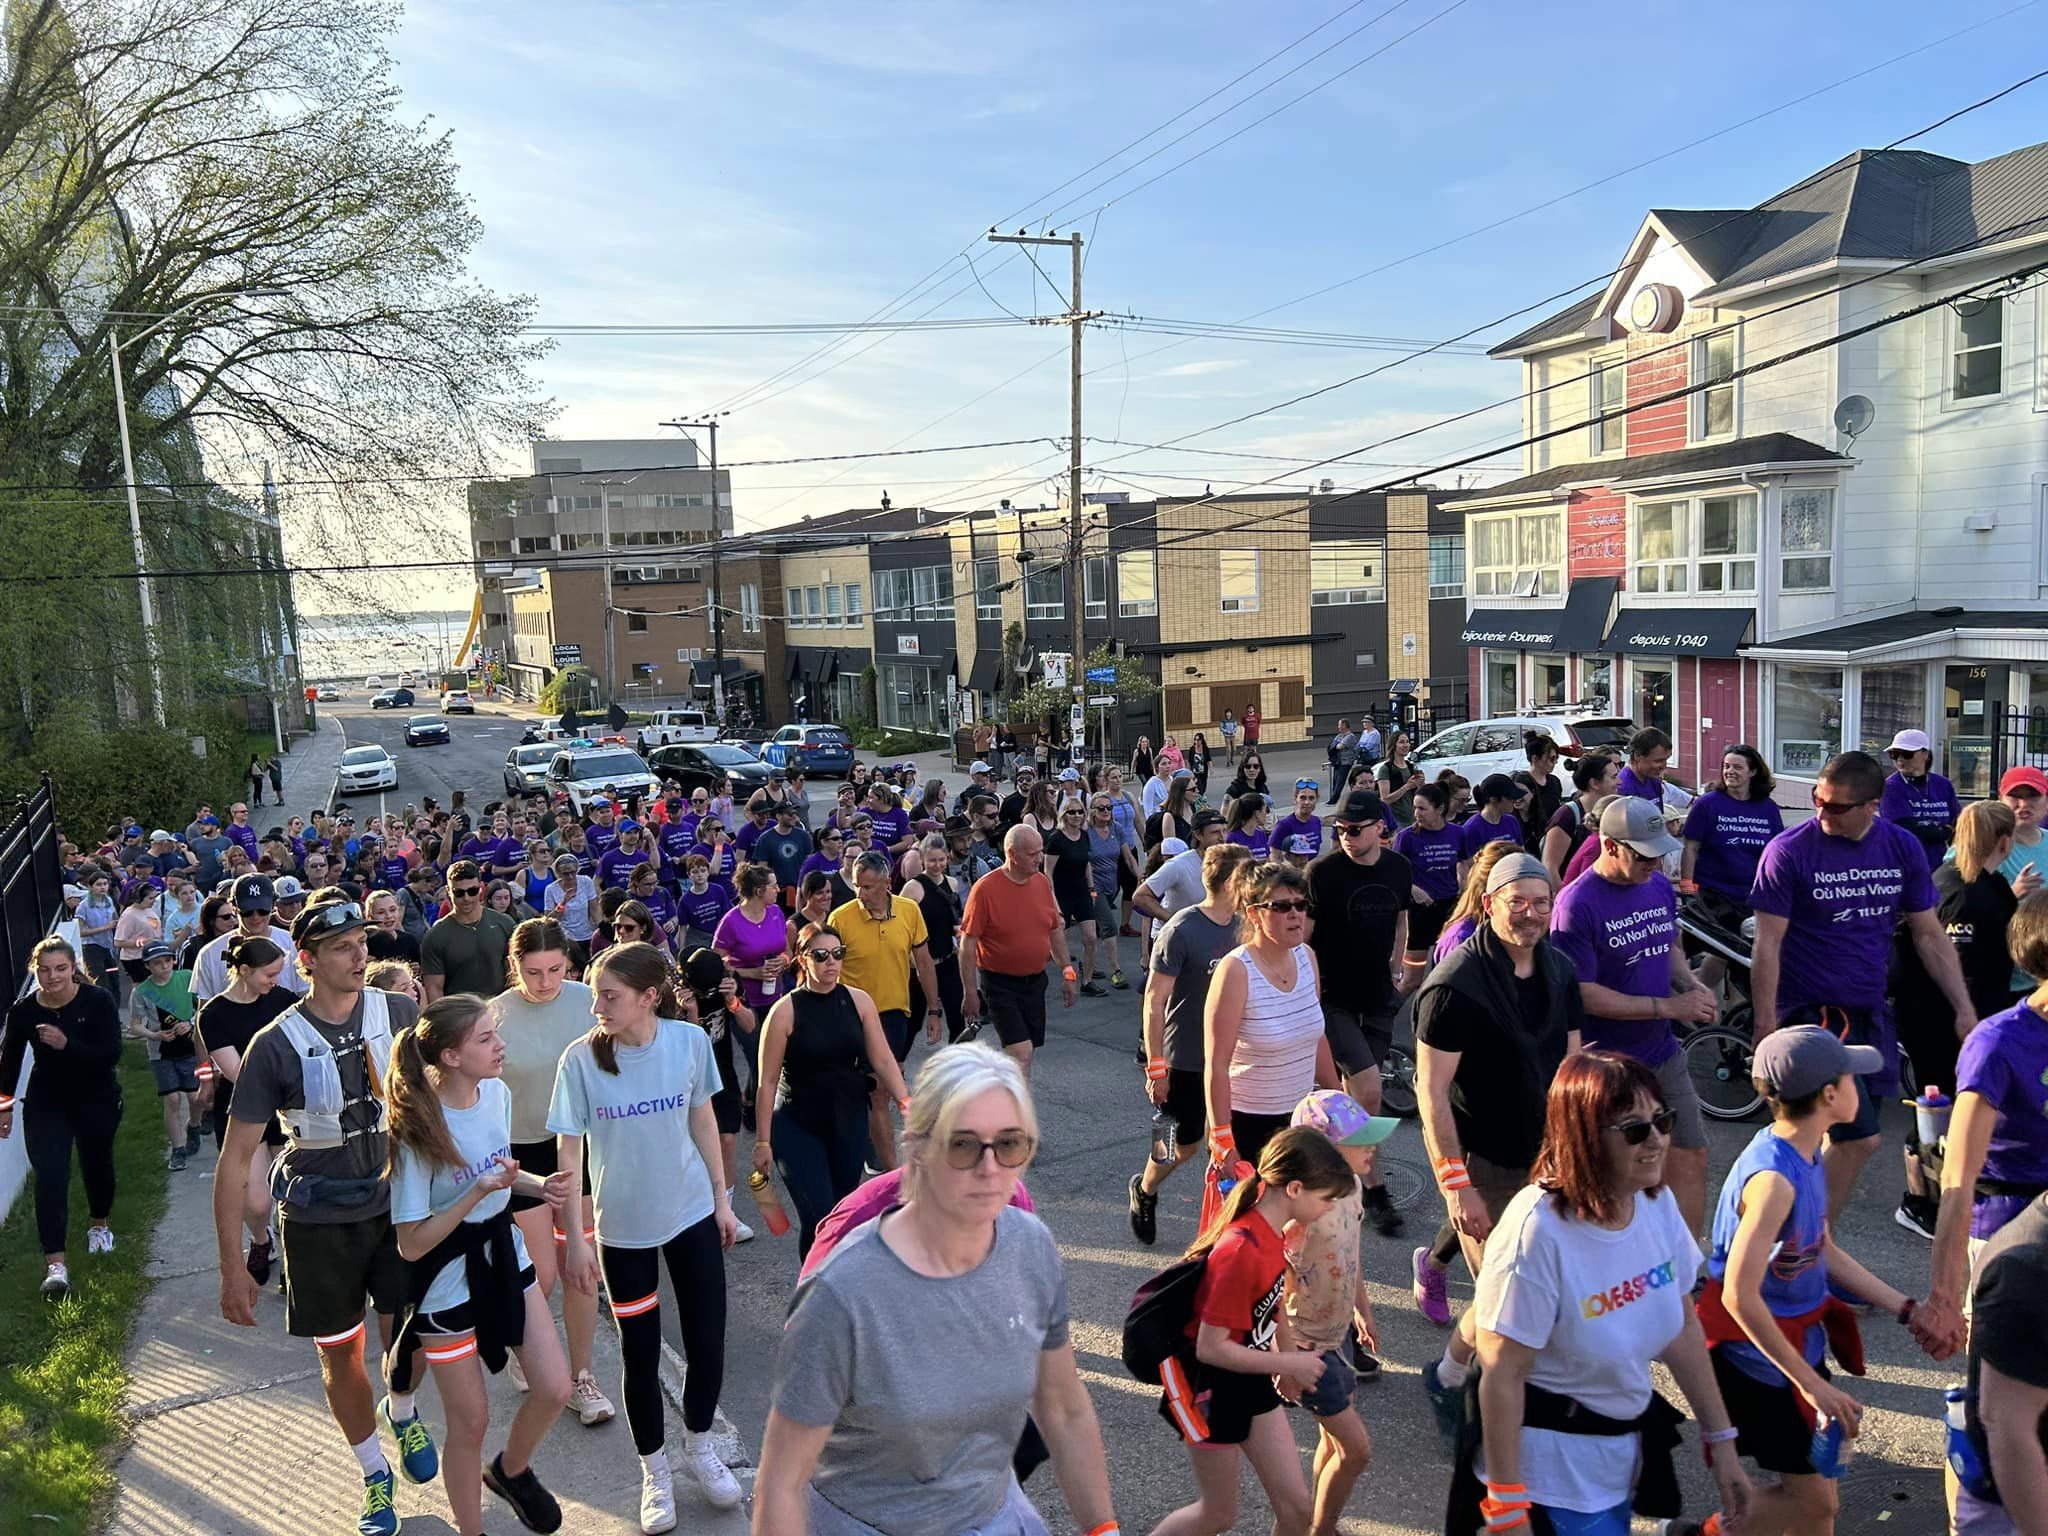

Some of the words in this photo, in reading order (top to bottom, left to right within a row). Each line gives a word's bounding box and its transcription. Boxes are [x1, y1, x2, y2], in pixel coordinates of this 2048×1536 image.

[1461, 630, 1507, 642] bijouterie
[1508, 631, 1553, 643] Fournier
[1629, 634, 1671, 647] depuis
[1674, 634, 1708, 647] 1940
[1968, 667, 1987, 678] 156
[1717, 815, 1738, 823] Nous
[1739, 815, 1769, 825] Donnons
[1814, 872, 1848, 883] Nous
[1849, 868, 1902, 881] Donnons
[1813, 887, 1834, 900] Où
[1835, 885, 1867, 898] Nous
[1605, 917, 1634, 933] Nous
[1632, 906, 1668, 924] Donnons
[1609, 934, 1628, 948] Où
[1647, 921, 1673, 936] Vivons
[596, 1093, 684, 1121] FILLACTIVE
[1580, 1260, 1675, 1319] LOVE&SPORT
[1253, 1291, 1274, 1318] CLUB
